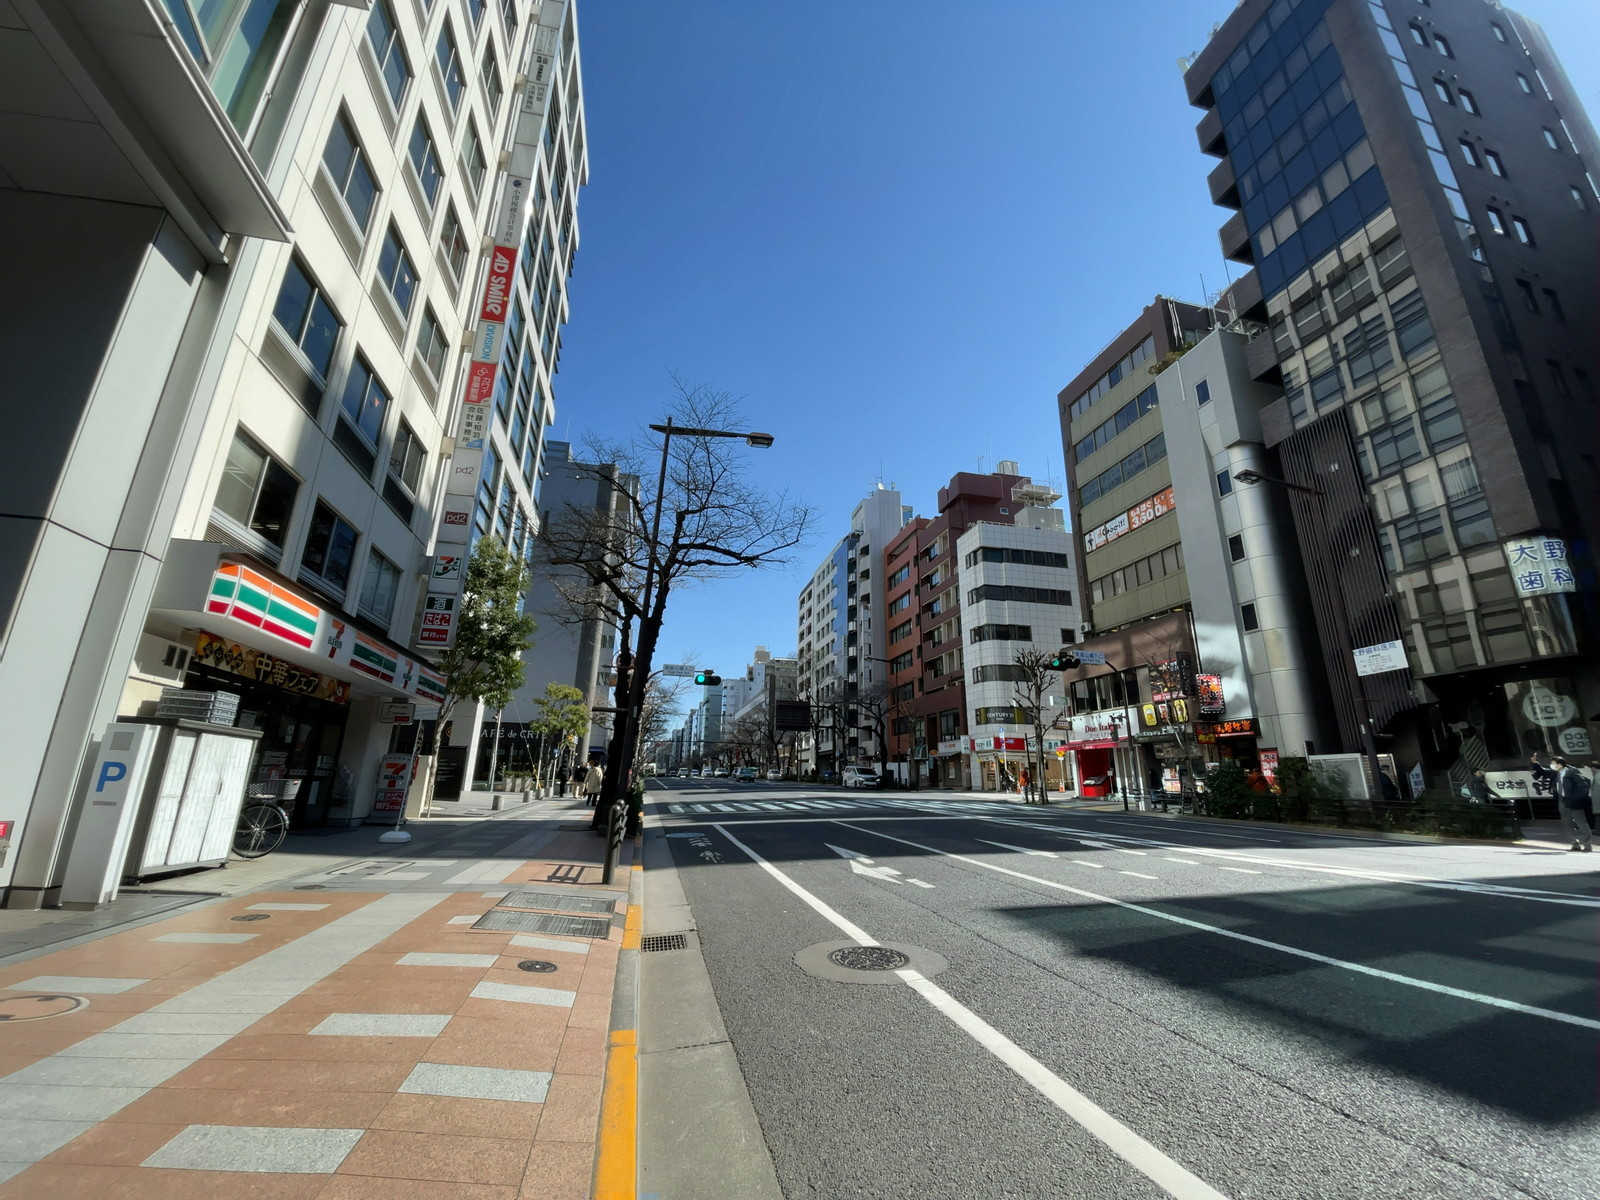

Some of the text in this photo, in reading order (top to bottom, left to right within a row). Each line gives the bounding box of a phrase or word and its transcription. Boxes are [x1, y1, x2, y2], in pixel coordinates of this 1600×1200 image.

[493, 252, 510, 274] AD
[481, 324, 496, 360] DIVISION
[461, 406, 477, 443] 会計事務所
[454, 465, 475, 475] pd2
[446, 512, 466, 524] pd2
[1508, 539, 1567, 565] 大野
[1517, 568, 1575, 592] 歯科
[432, 597, 447, 610] 酒
[424, 613, 450, 626] たばこ
[256, 653, 319, 690] 中華フェア
[480, 727, 505, 738] AFÉ
[507, 730, 517, 739] de
[95, 761, 127, 792] P
